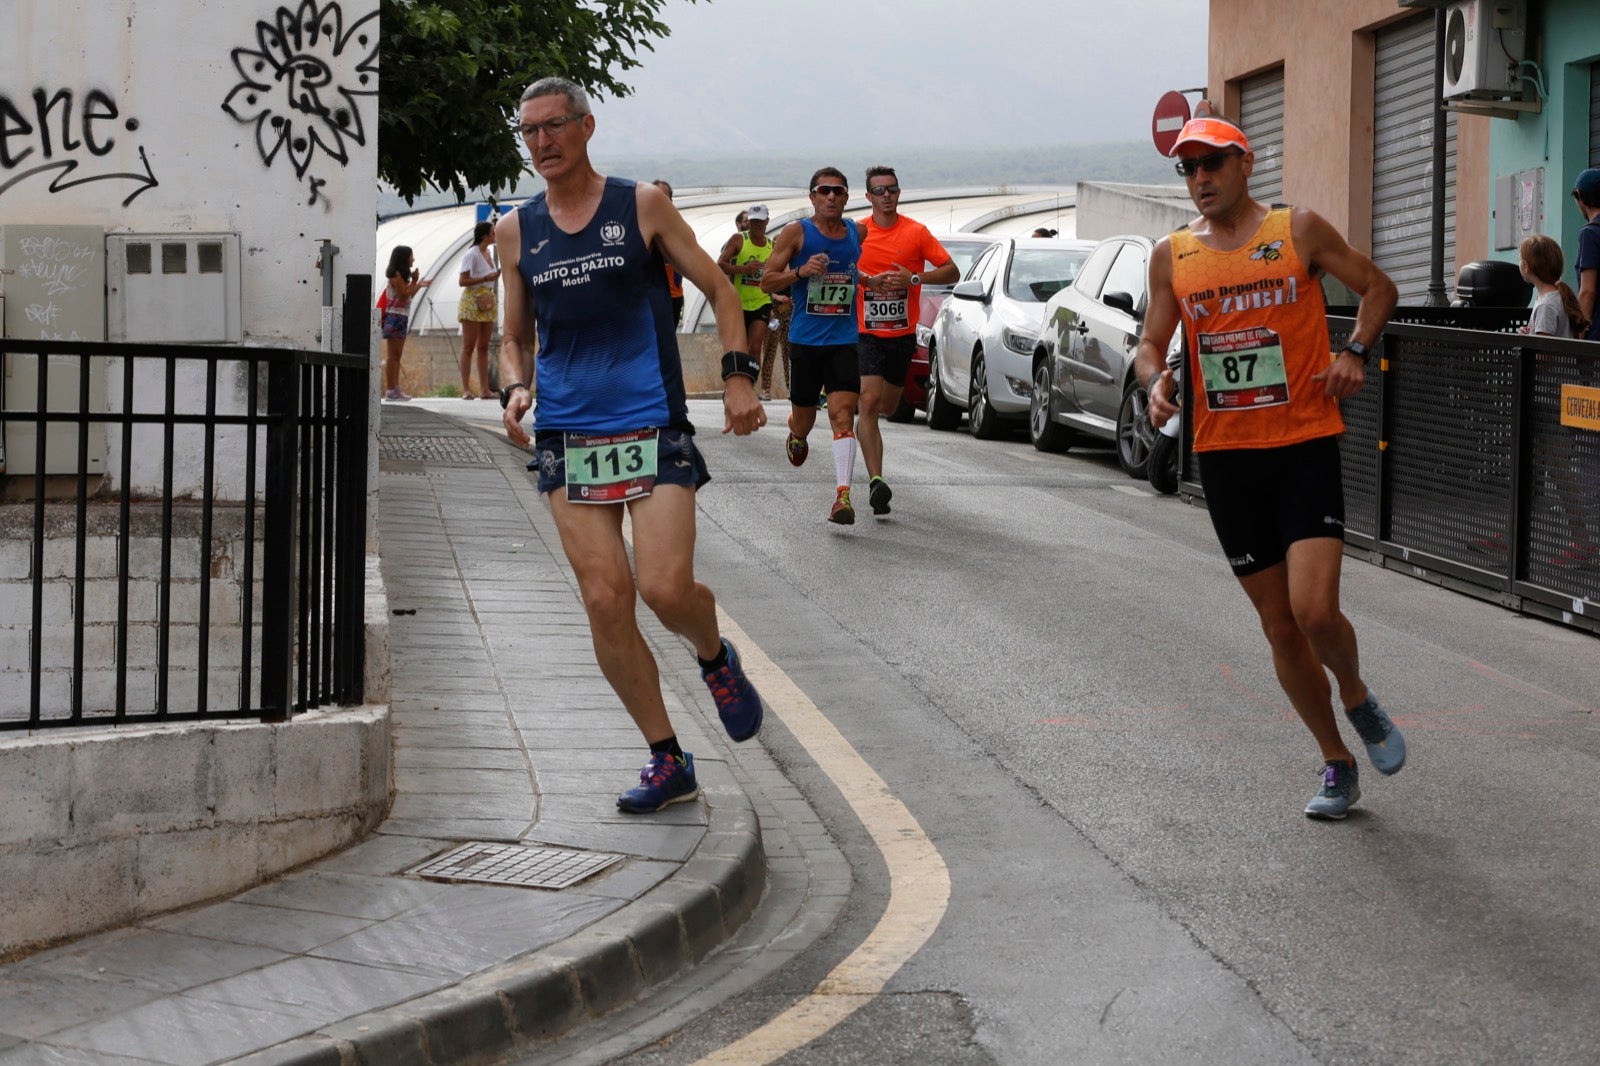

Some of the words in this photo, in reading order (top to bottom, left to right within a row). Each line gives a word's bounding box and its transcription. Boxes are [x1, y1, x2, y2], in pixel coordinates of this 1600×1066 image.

[604, 225, 621, 240] 30
[532, 266, 569, 287] PAZITO
[571, 267, 580, 276] a
[581, 256, 625, 274] PAZITO
[562, 273, 591, 287] Motril
[821, 286, 848, 301] 173
[1189, 289, 1215, 303] Club
[1218, 278, 1284, 298] Deportivo
[1218, 276, 1297, 314] ZUBIA
[869, 302, 905, 317] 3066
[1222, 353, 1258, 384] 87
[584, 444, 644, 479] 113
